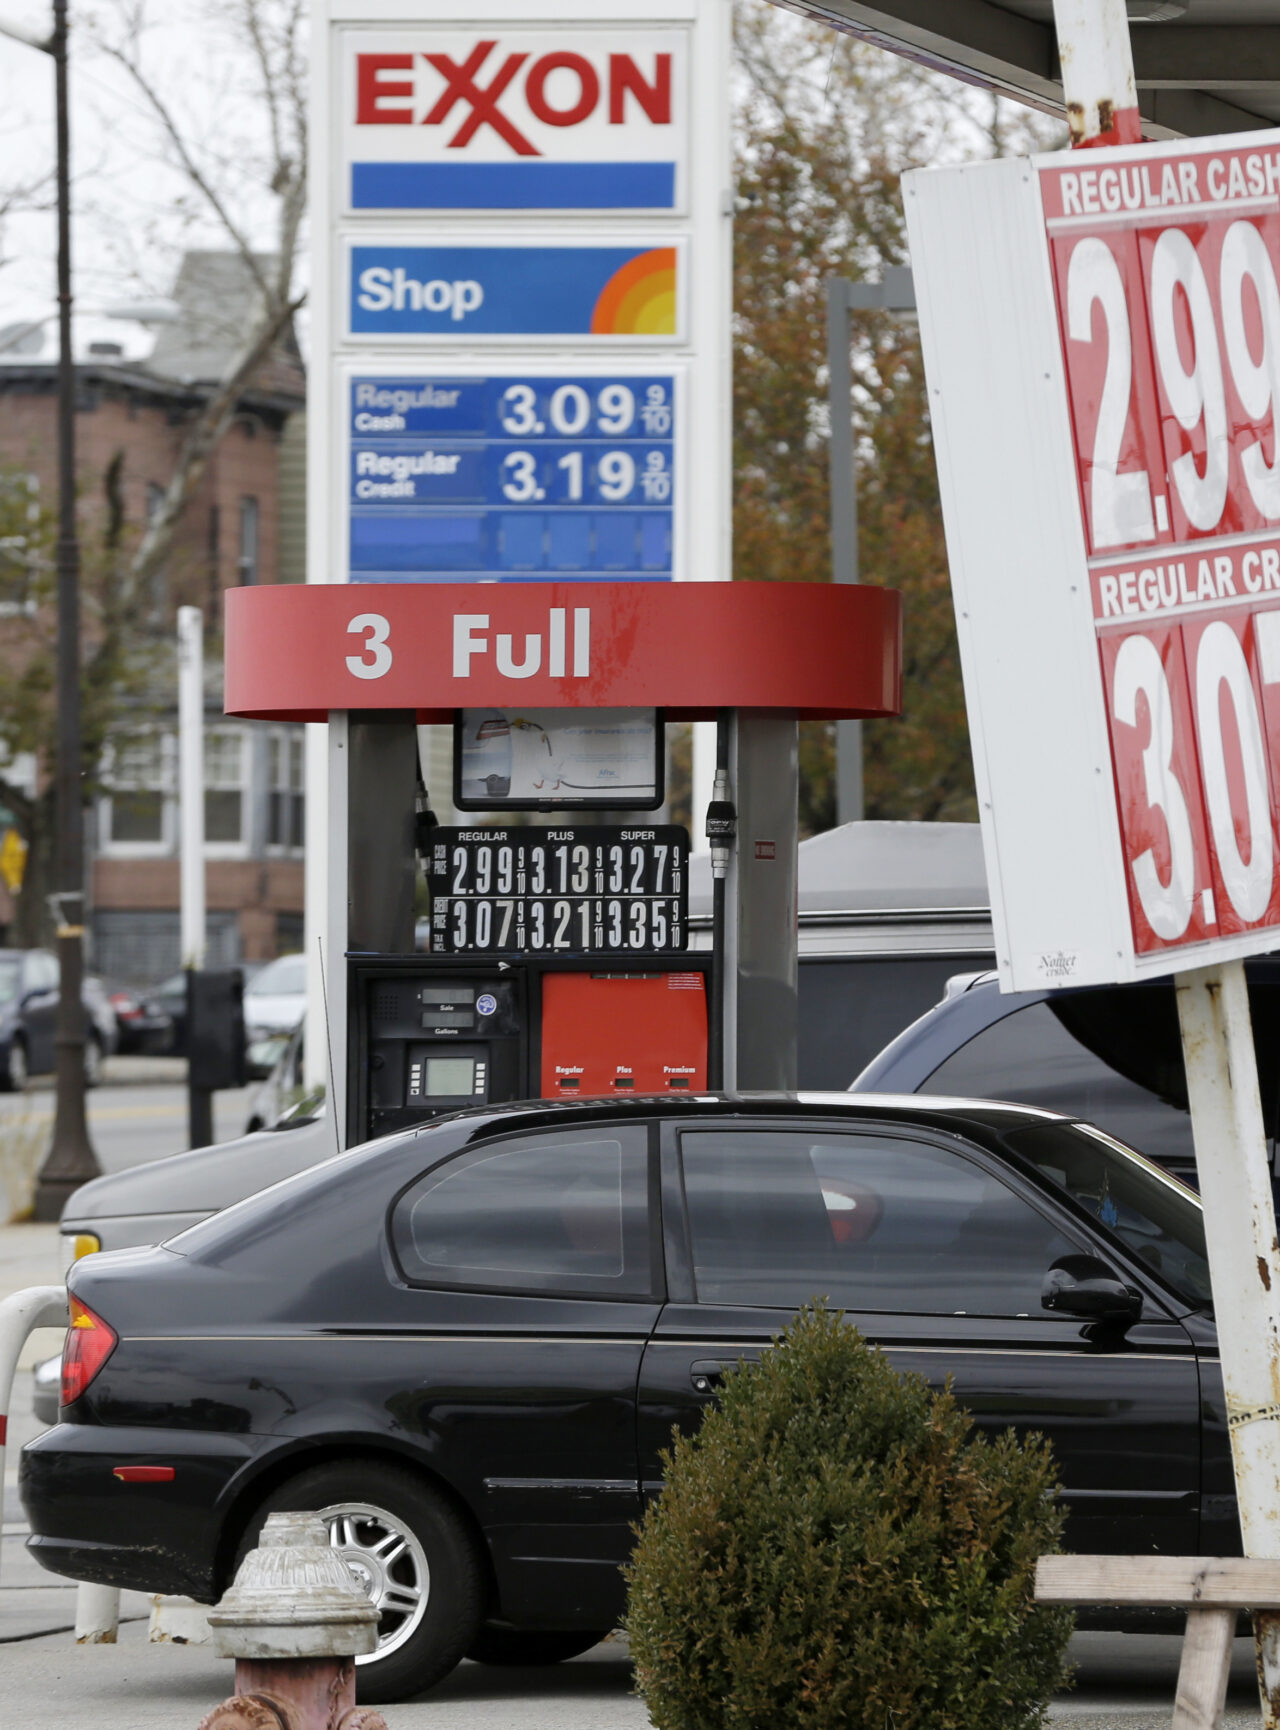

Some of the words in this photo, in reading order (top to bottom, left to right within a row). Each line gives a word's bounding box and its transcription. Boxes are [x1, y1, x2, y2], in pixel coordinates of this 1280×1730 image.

[355, 40, 672, 156] EXXON
[1059, 160, 1201, 216] REGULAR
[357, 266, 484, 321] Shop
[354, 412, 406, 432] Cash
[355, 383, 463, 413] Regular
[502, 384, 636, 435] 3.09
[355, 449, 463, 480] Regular
[502, 450, 636, 501] 3.19
[355, 479, 417, 499] Credit
[1098, 557, 1234, 617] REGULAR
[345, 613, 393, 679] 3
[453, 607, 590, 678] Full
[458, 832, 508, 842] REGULAR
[547, 831, 575, 841] PLUS
[620, 831, 656, 840] SUPER
[453, 846, 513, 894] 2.99
[531, 846, 590, 894] 3.13
[609, 846, 668, 894] 3.27
[453, 900, 514, 948] 3.07
[531, 900, 590, 948] 3.21
[608, 900, 667, 948] 3.35
[555, 1066, 584, 1075] Regular
